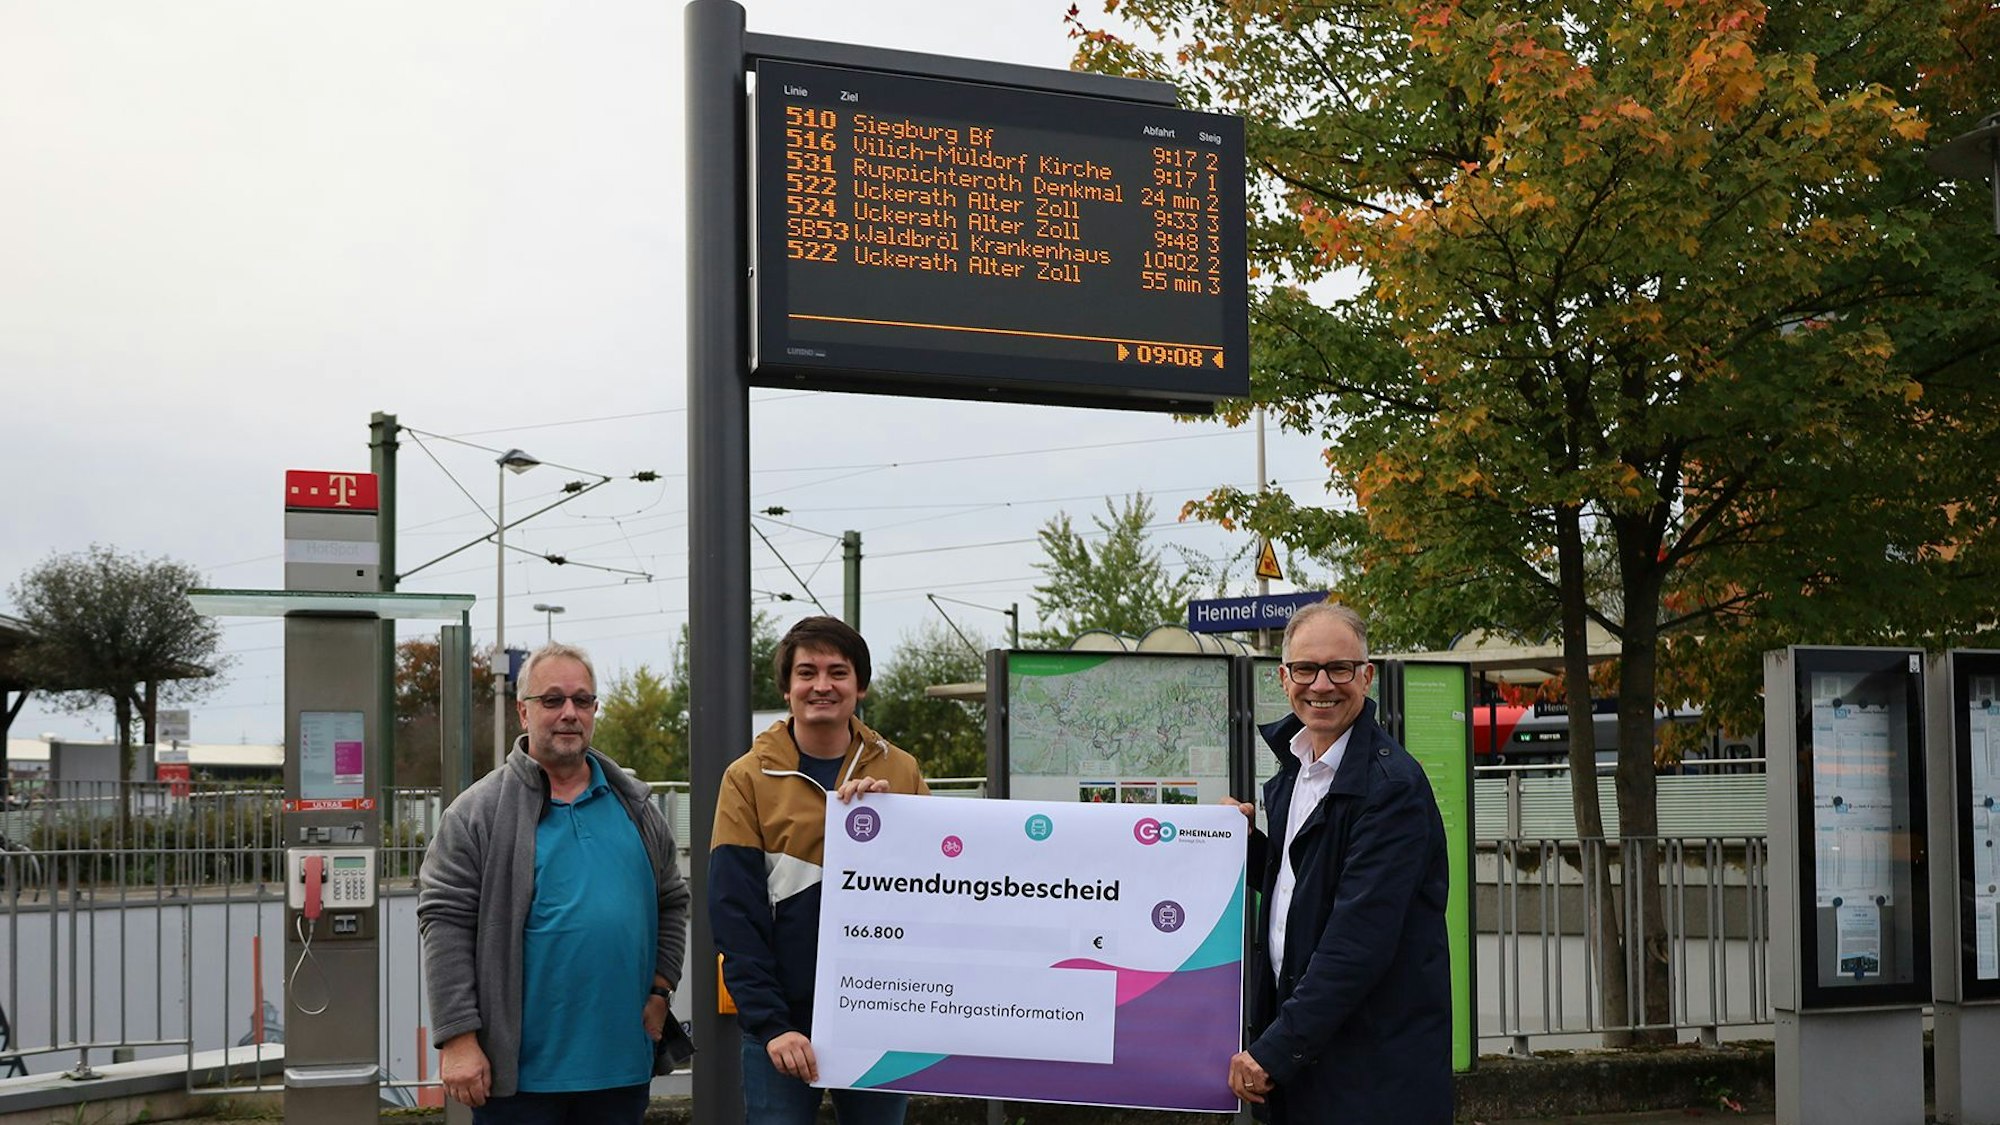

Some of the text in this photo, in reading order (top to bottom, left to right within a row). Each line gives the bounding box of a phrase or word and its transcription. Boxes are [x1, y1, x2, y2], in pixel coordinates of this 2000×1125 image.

[784, 85, 859, 102] Linie Ziel
[786, 106, 1219, 171] 510 Siegburg Bf 9:17 2
[1142, 125, 1222, 145] Abfahrt Steig
[786, 128, 1218, 192] 516 Vilich-Müldorf Kirche 9:17 1
[786, 151, 1219, 213] 531 Ruppichteroth Denkmal 24 min 2
[786, 173, 1219, 233] 522 Uckerath Alter Zoll 9:33 3
[787, 195, 1220, 254] 524 Uckerath Alter Zoll 9:48 3
[787, 217, 1220, 275] SB53 Waldbröl Krankenhaus 10:02 2
[787, 240, 1221, 295] 522 Uckerath Alter Zoll 55 min 3
[1137, 345, 1203, 367] 09:08
[329, 474, 356, 506] T
[1197, 601, 1297, 622] Hennef (Sieg)
[313, 801, 342, 810] ULTRAS
[1179, 829, 1232, 839] RHEINLAND
[842, 870, 1120, 901] Zuwendungsbescheid
[843, 925, 1103, 949] 166.800 €
[841, 976, 954, 996] Modernisierung
[839, 996, 1085, 1022] Dynamische Fahrgastinformation
